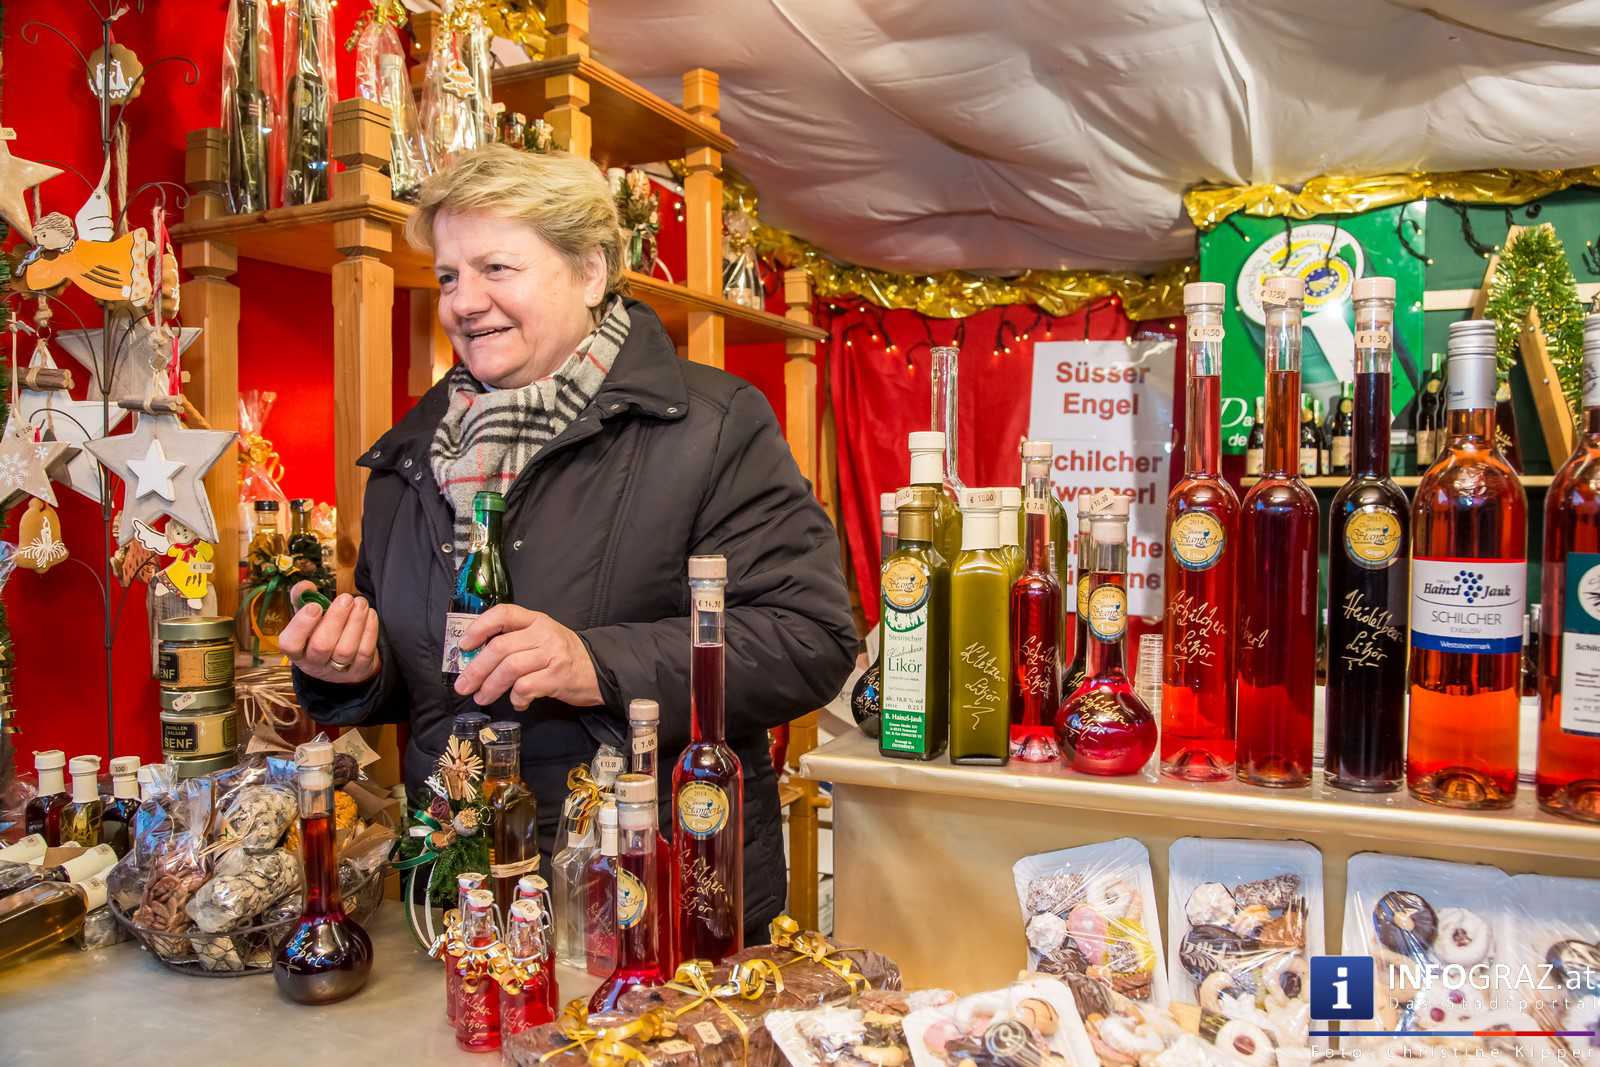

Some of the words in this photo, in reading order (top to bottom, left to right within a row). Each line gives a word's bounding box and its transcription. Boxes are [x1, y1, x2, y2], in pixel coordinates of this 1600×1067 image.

[1056, 361, 1150, 384] Süsser
[1063, 393, 1139, 420] Engel
[1052, 449, 1163, 473] chilcher
[1423, 582, 1461, 596] Hainzl
[1480, 585, 1511, 599] Jauk
[1431, 610, 1503, 626] SCHILCHER
[887, 656, 923, 673] Likör
[160, 668, 176, 682] ENF
[164, 736, 194, 749] SENF
